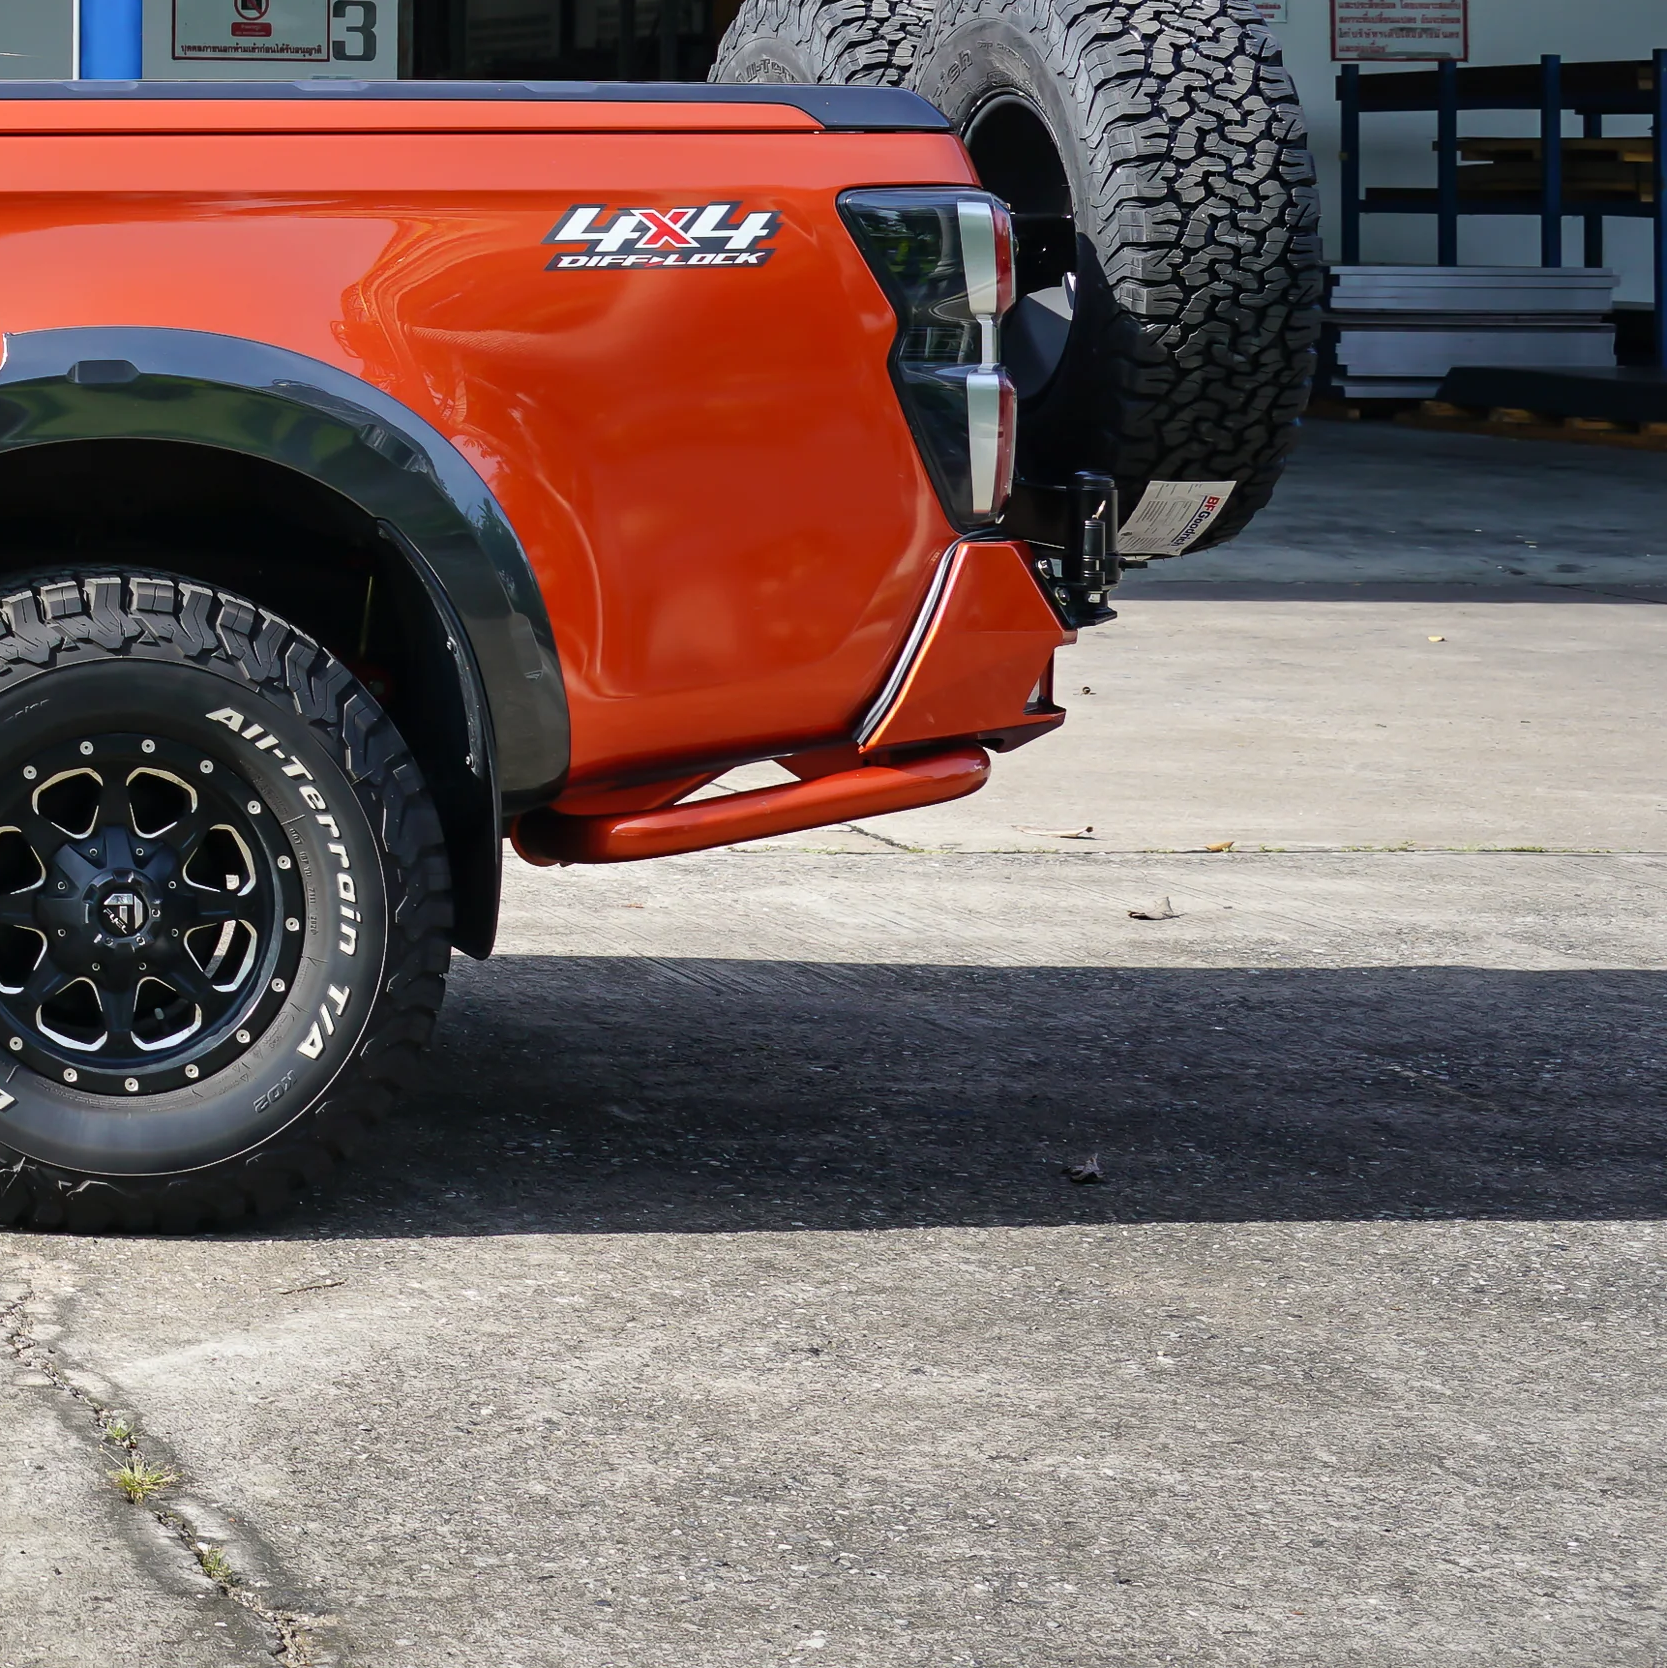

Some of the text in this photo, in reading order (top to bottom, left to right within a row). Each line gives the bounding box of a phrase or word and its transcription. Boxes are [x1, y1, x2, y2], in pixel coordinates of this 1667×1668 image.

[331, 0, 376, 61] 3
[1170, 495, 1221, 547] BFGoodrich
[206, 705, 359, 958] All-Terrain
[295, 983, 352, 1062] T/A
[102, 907, 128, 935] FUEL
